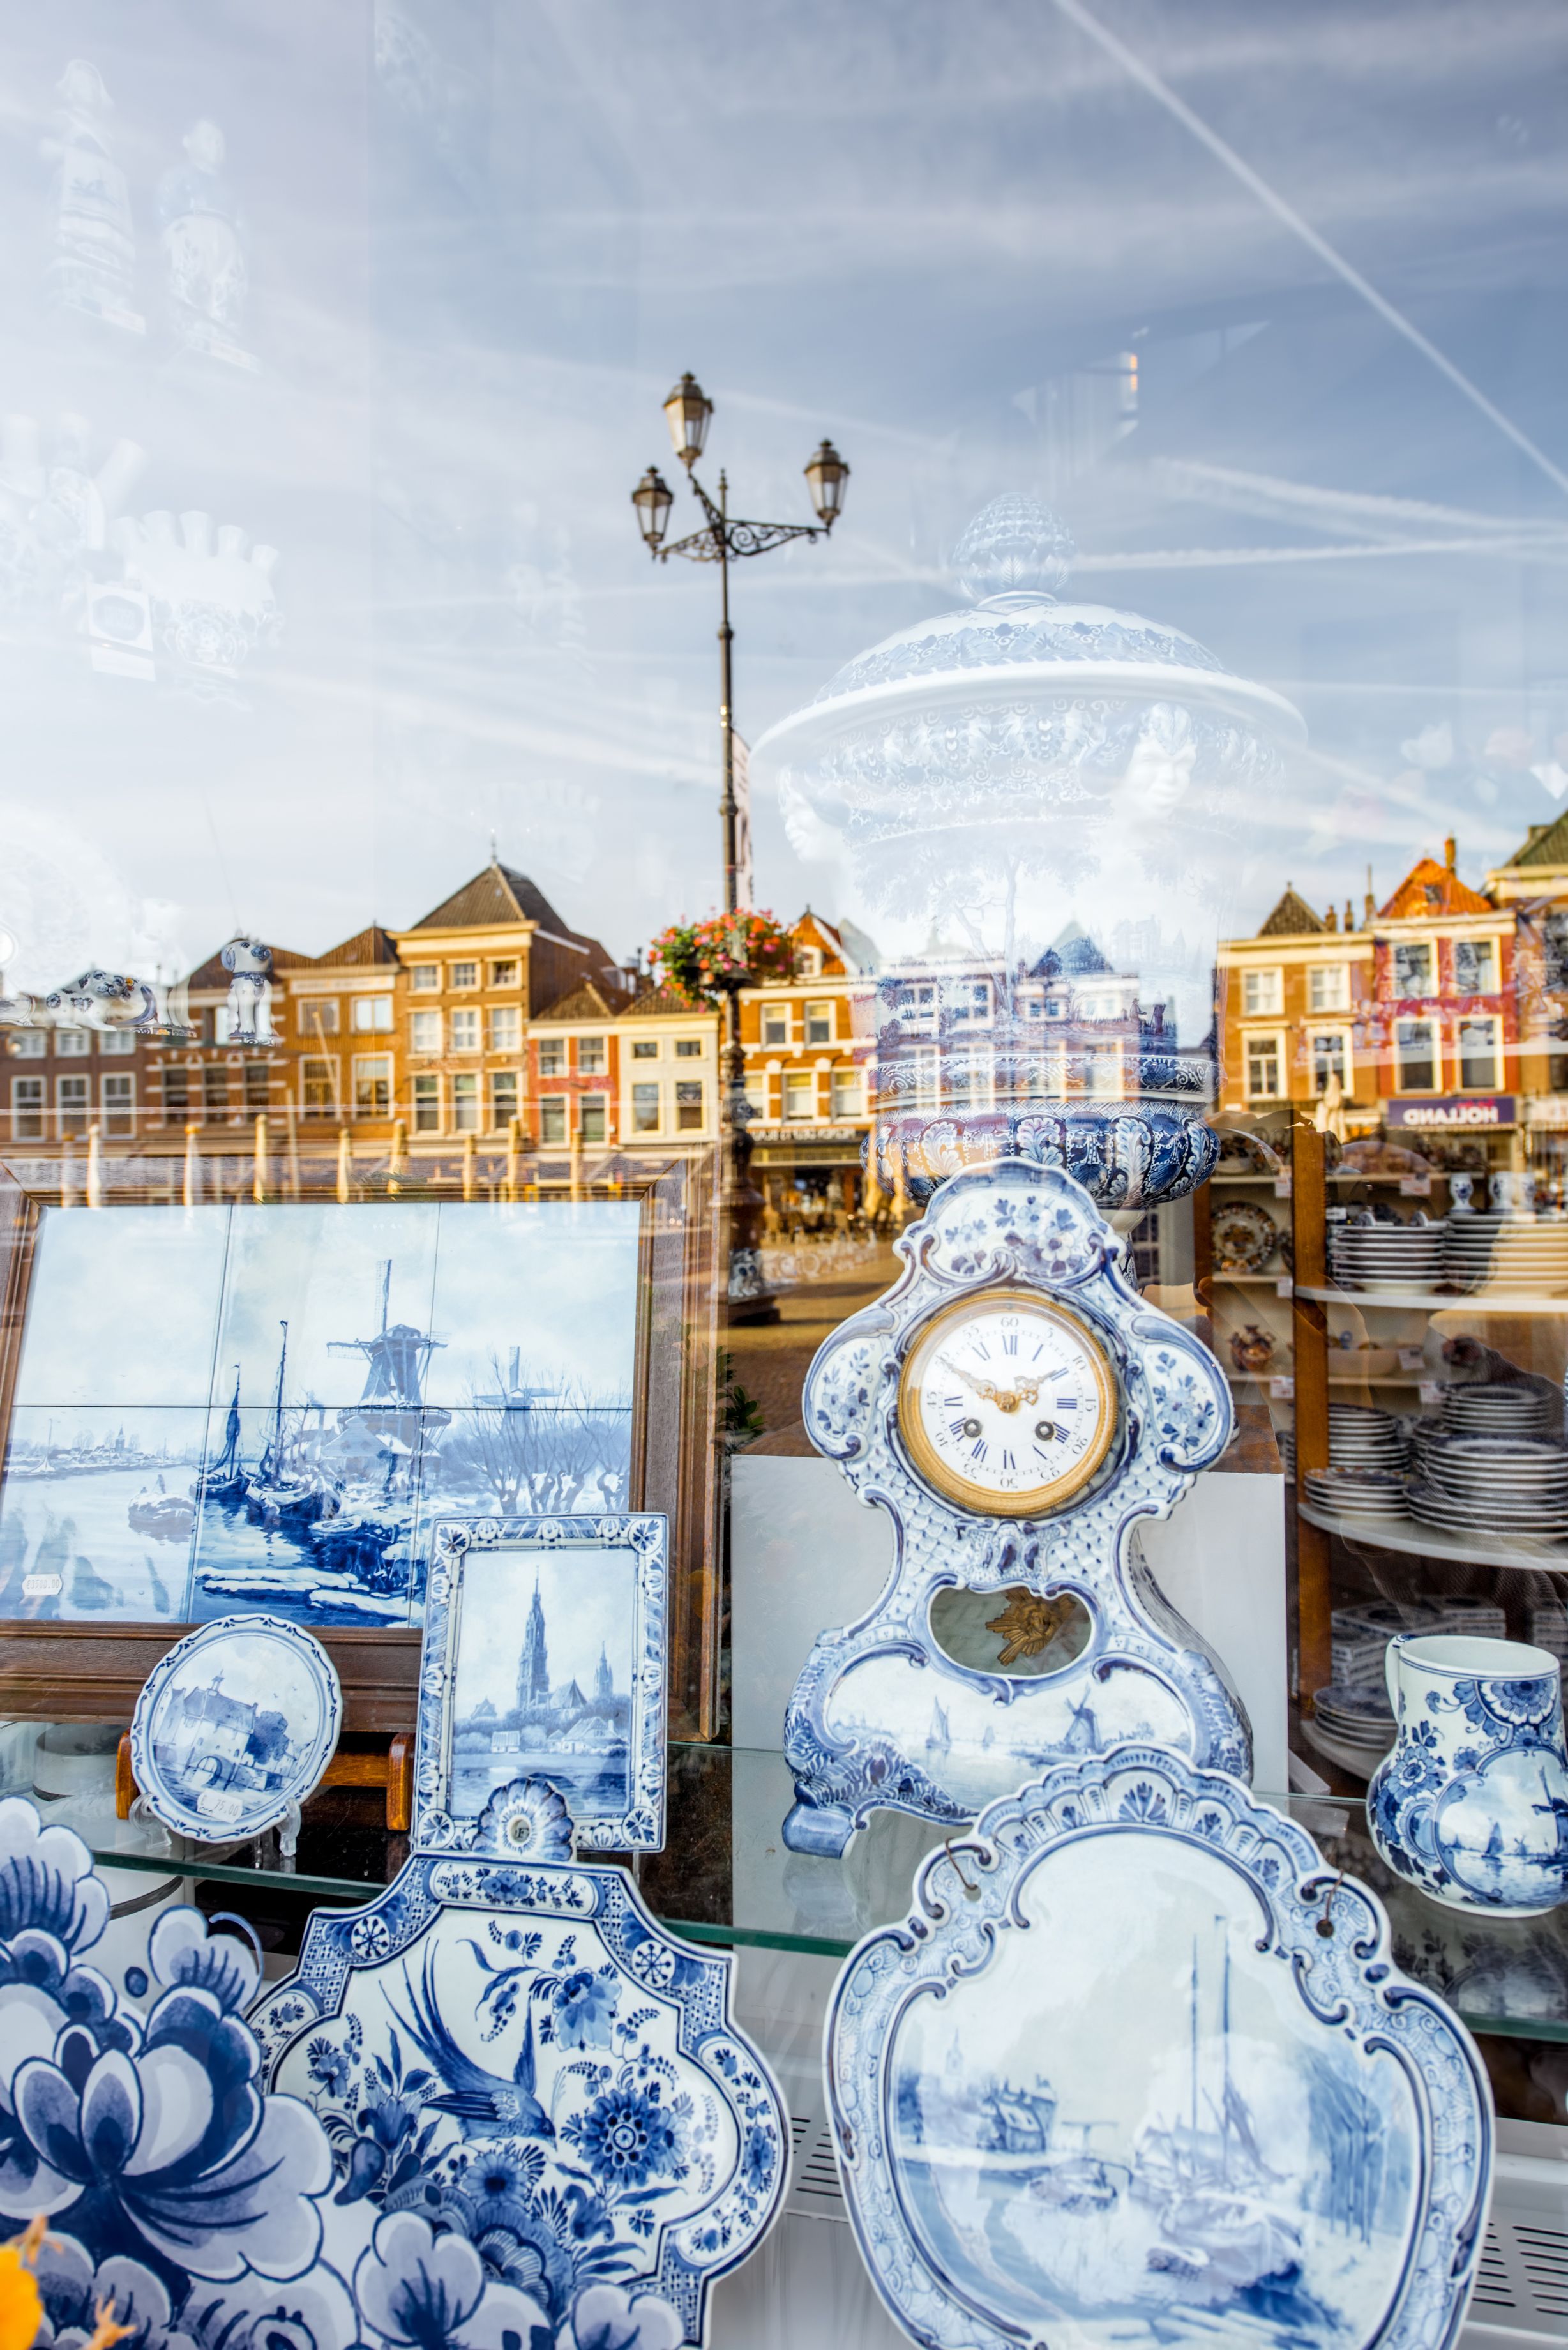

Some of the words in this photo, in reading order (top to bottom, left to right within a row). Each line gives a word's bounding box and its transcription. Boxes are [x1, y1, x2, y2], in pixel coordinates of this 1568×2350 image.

[1001, 1317, 1019, 1327] 60
[962, 1325, 979, 1338] 55
[1044, 1327, 1054, 1338] 5
[1032, 1344, 1044, 1361] I
[1072, 1355, 1086, 1370] 10
[1049, 1367, 1070, 1382] II
[926, 1391, 937, 1409] 45
[1056, 1398, 1078, 1409] III
[1085, 1399, 1096, 1412] 15
[935, 1432, 949, 1447] 40
[1071, 1437, 1088, 1455] 20
[963, 1462, 978, 1480] 35
[1039, 1467, 1060, 1482] 25
[1000, 1477, 1019, 1489] 30
[214, 1798, 240, 1817] 75.00
